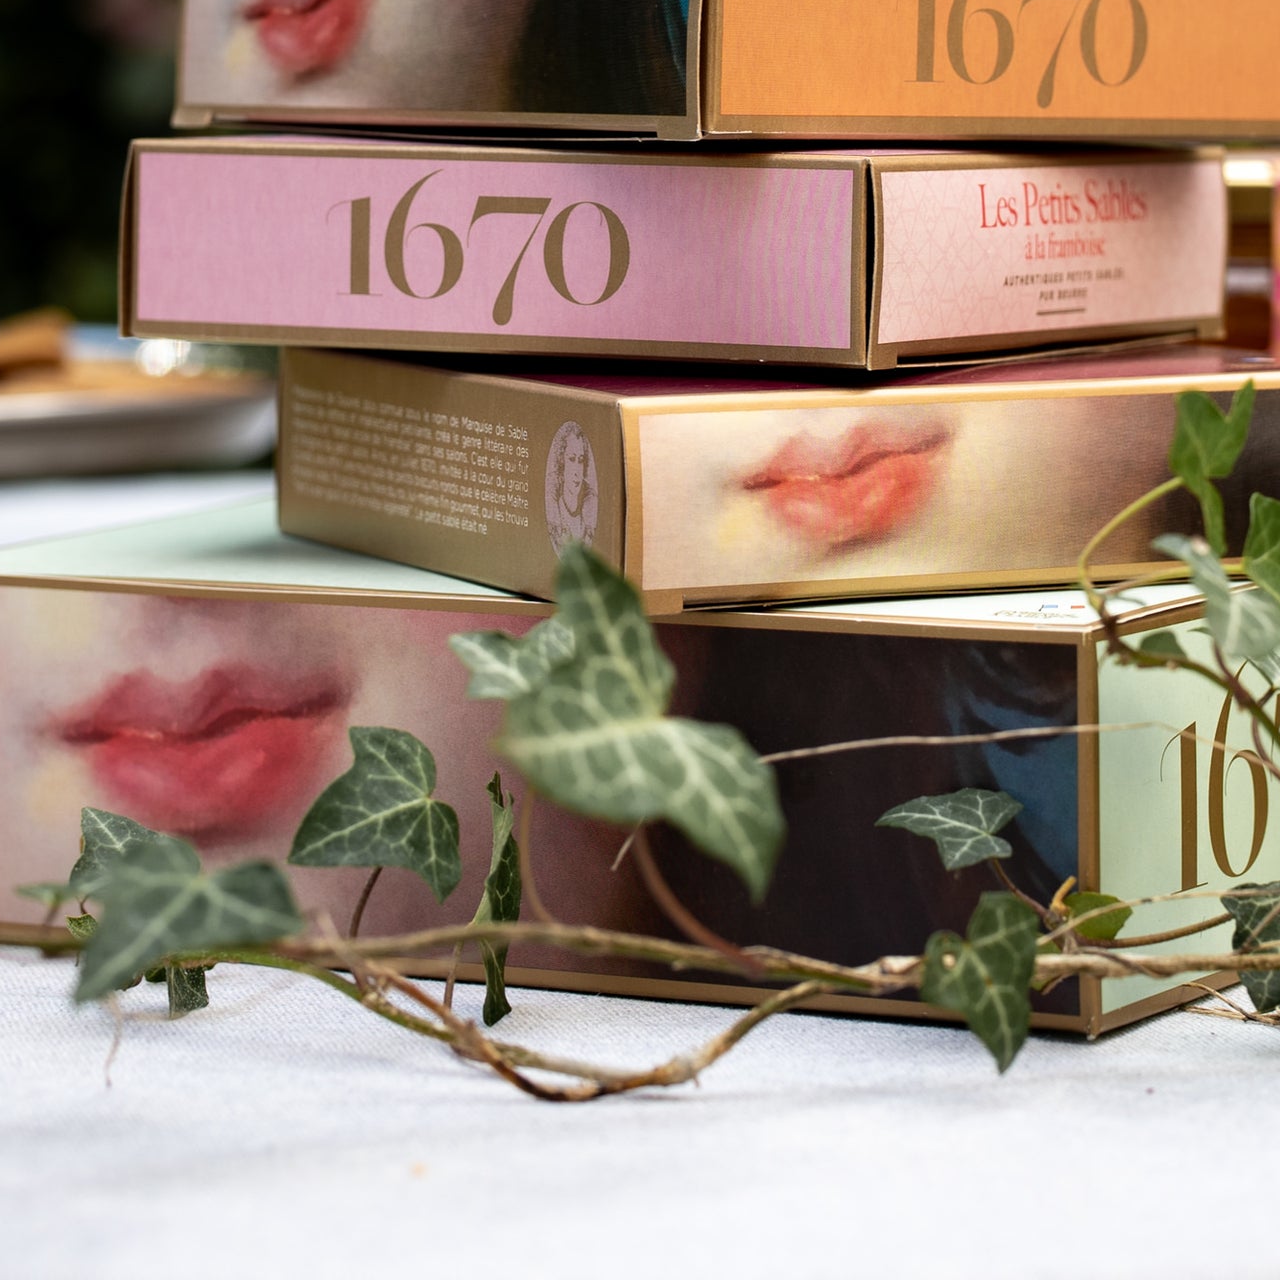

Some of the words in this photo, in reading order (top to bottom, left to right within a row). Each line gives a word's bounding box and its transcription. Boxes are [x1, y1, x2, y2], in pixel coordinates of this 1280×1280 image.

[978, 183, 1019, 228] Les
[1022, 181, 1082, 227] Petits
[326, 168, 631, 326] 1670
[1034, 233, 1046, 260] la
[1047, 230, 1107, 259] framboise
[1003, 271, 1064, 287] AUTHENTIQUES
[1039, 289, 1055, 302] PUR
[461, 416, 493, 435] Marquise
[495, 422, 505, 437] de
[516, 443, 529, 459] des
[489, 456, 503, 471] elle
[505, 461, 517, 474] qui
[518, 461, 529, 475] fut
[478, 472, 493, 486] cour
[507, 479, 529, 493] grand
[481, 506, 493, 520] qui
[494, 507, 505, 522] les
[506, 510, 529, 527] trouva
